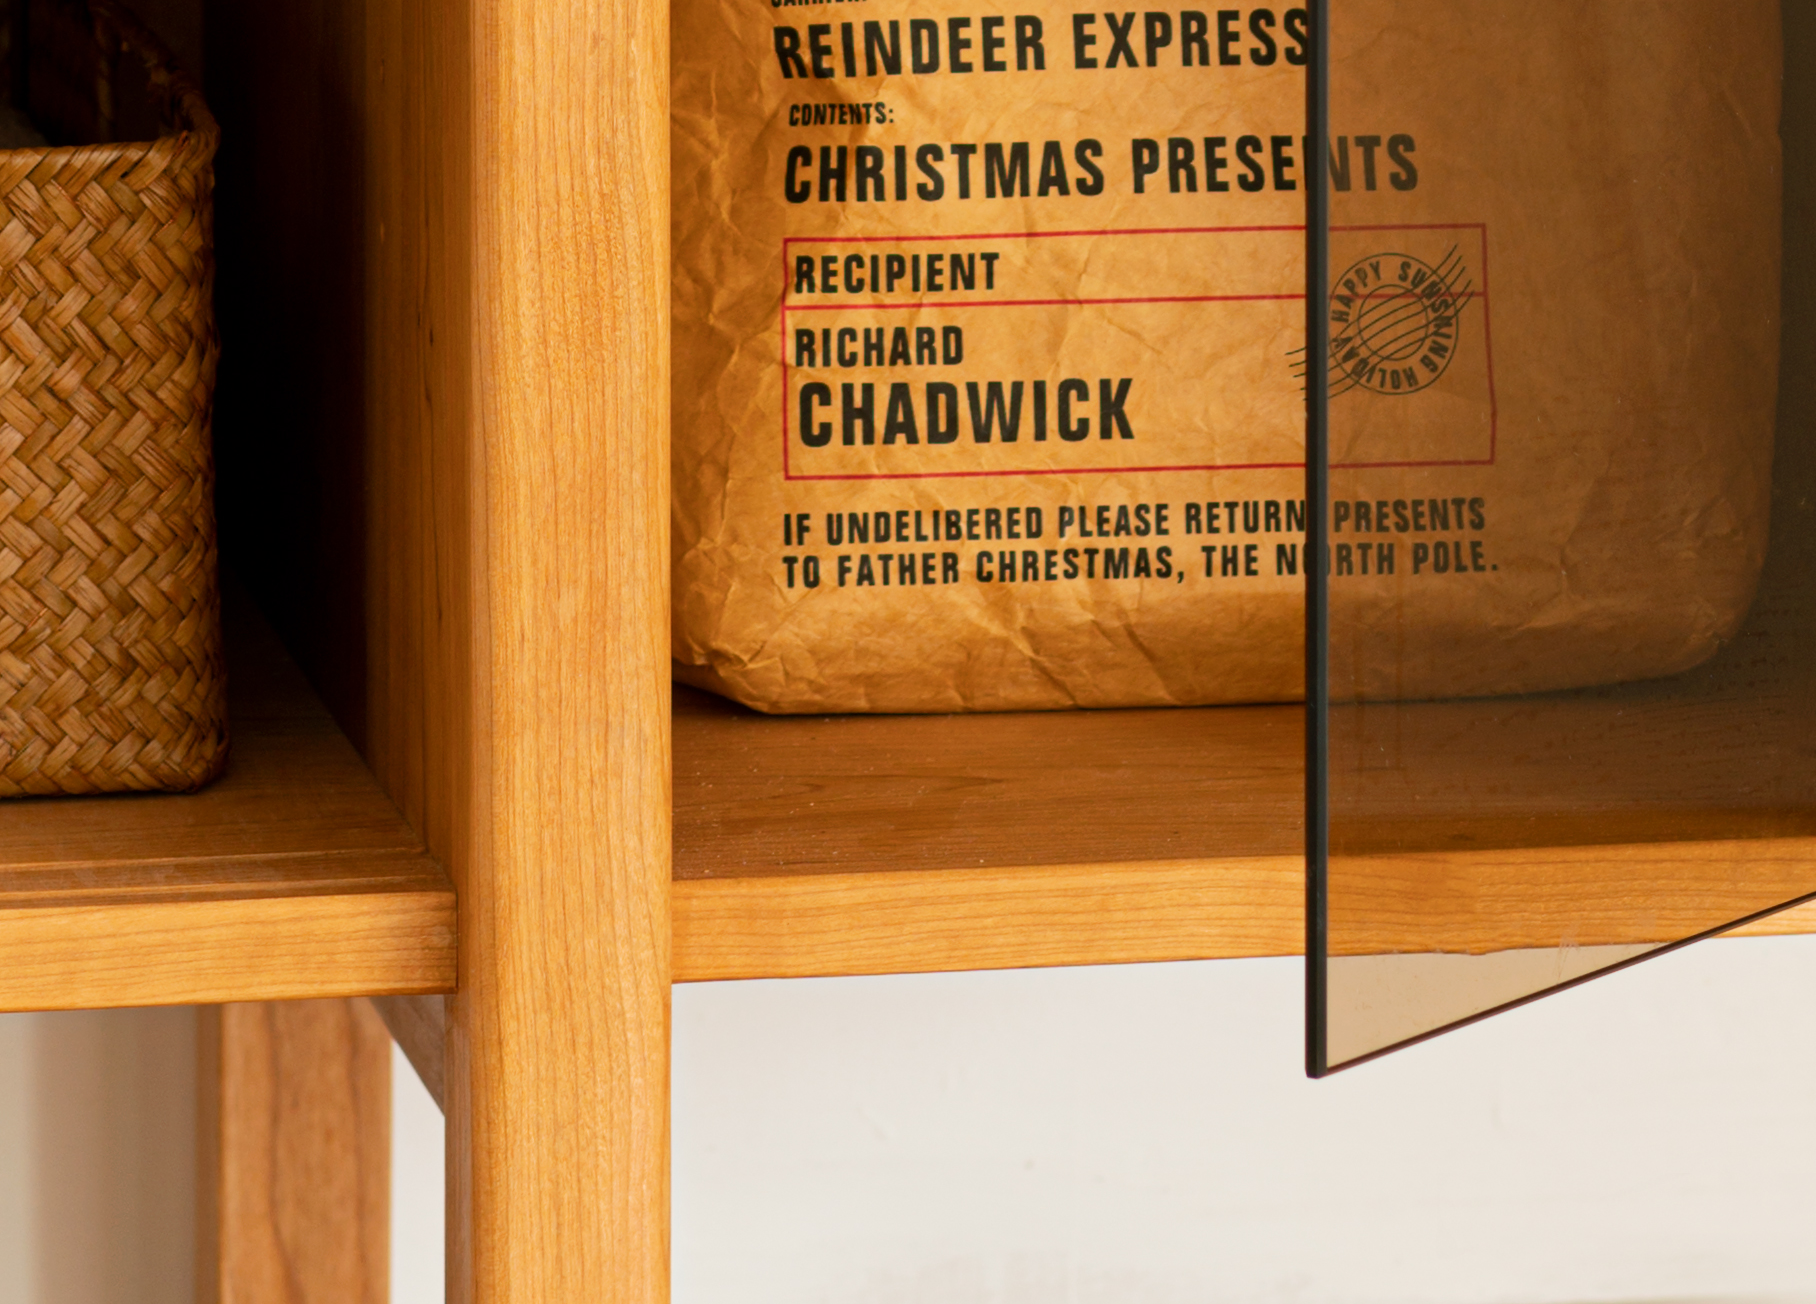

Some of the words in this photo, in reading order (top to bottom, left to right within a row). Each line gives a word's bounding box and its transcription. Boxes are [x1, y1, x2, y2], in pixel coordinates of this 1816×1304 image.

[773, 15, 1045, 80] REINDEER
[1073, 7, 1307, 69] EXPRESS
[789, 102, 893, 127] CONTENTS:
[784, 139, 1104, 203] CHRISTMAS
[1132, 133, 1418, 193] PRESENTS
[795, 253, 999, 293] RECIPIENT
[1331, 259, 1382, 323] HAPPY
[796, 326, 963, 367] RICHARD
[1332, 336, 1420, 390] HOLIDAY
[800, 378, 1134, 447] CHADWICK
[784, 514, 810, 545] IF
[827, 506, 1043, 546] UNDELIBERED
[1059, 504, 1169, 538] PLEASE
[1186, 499, 1307, 534] RETURN
[1335, 497, 1485, 532] PRESENTS
[782, 556, 820, 588] TO
[838, 552, 958, 587] FATHER
[976, 546, 1184, 583] CHRESTMAS,
[1202, 544, 1258, 577] THE
[1276, 542, 1395, 577] NRTH
[1413, 541, 1498, 574] POLE.
